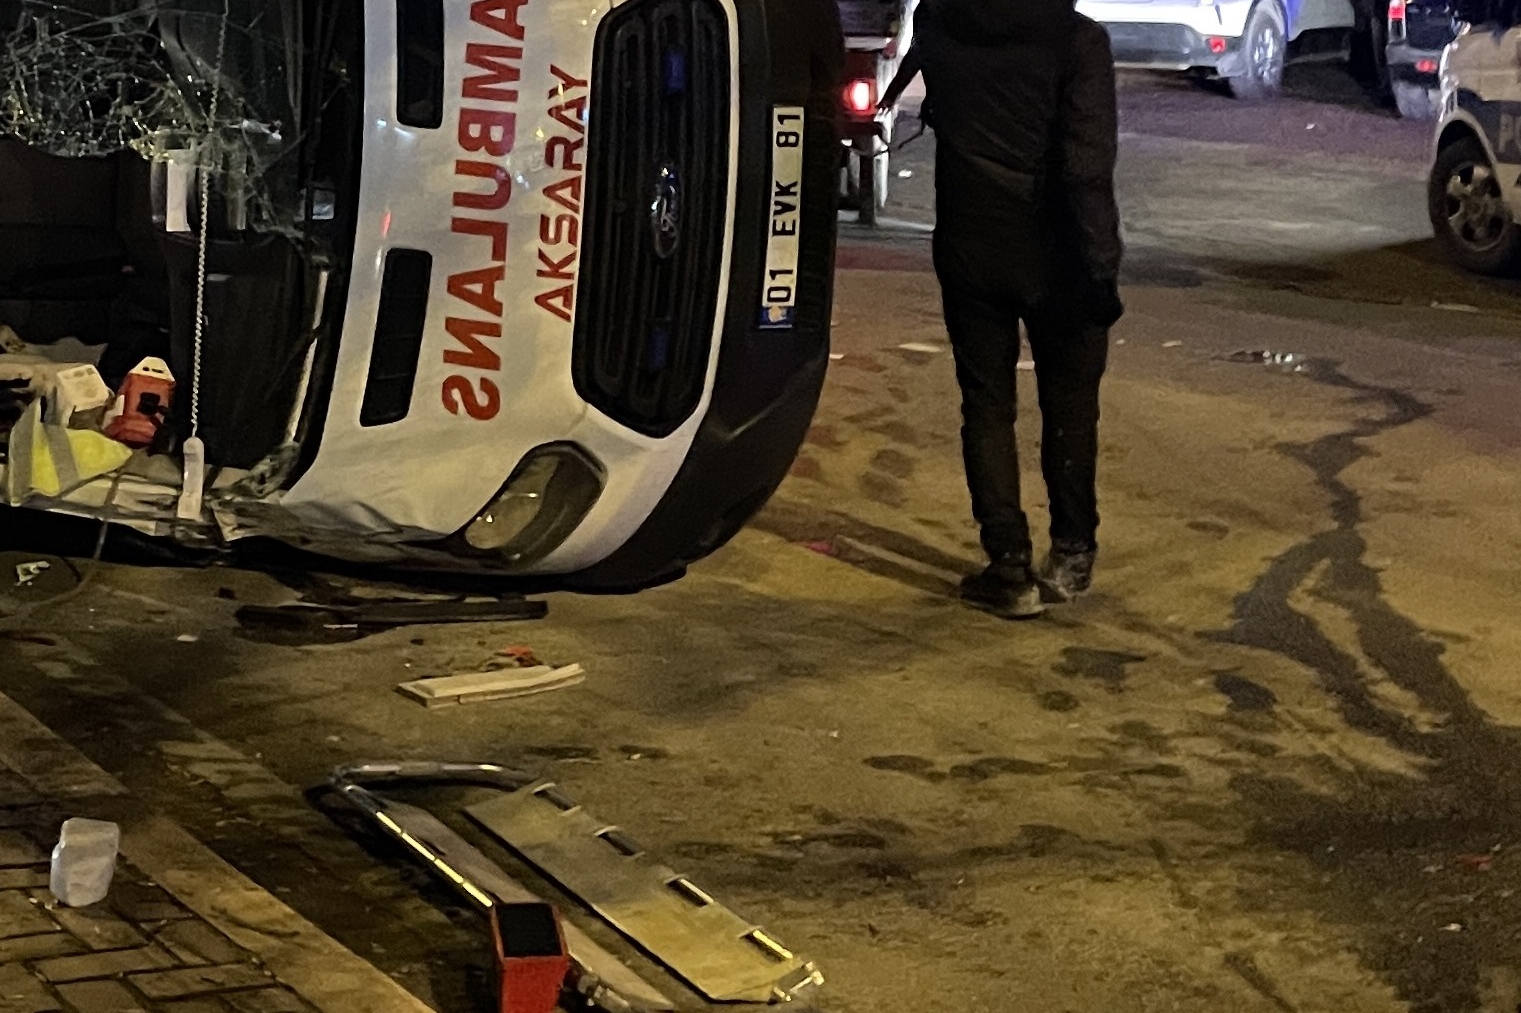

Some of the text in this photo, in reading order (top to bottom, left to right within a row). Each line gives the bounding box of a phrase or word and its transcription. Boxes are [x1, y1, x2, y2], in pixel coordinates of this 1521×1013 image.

[534, 64, 588, 322] AKSARAY
[767, 114, 802, 303] 01 EVK 81
